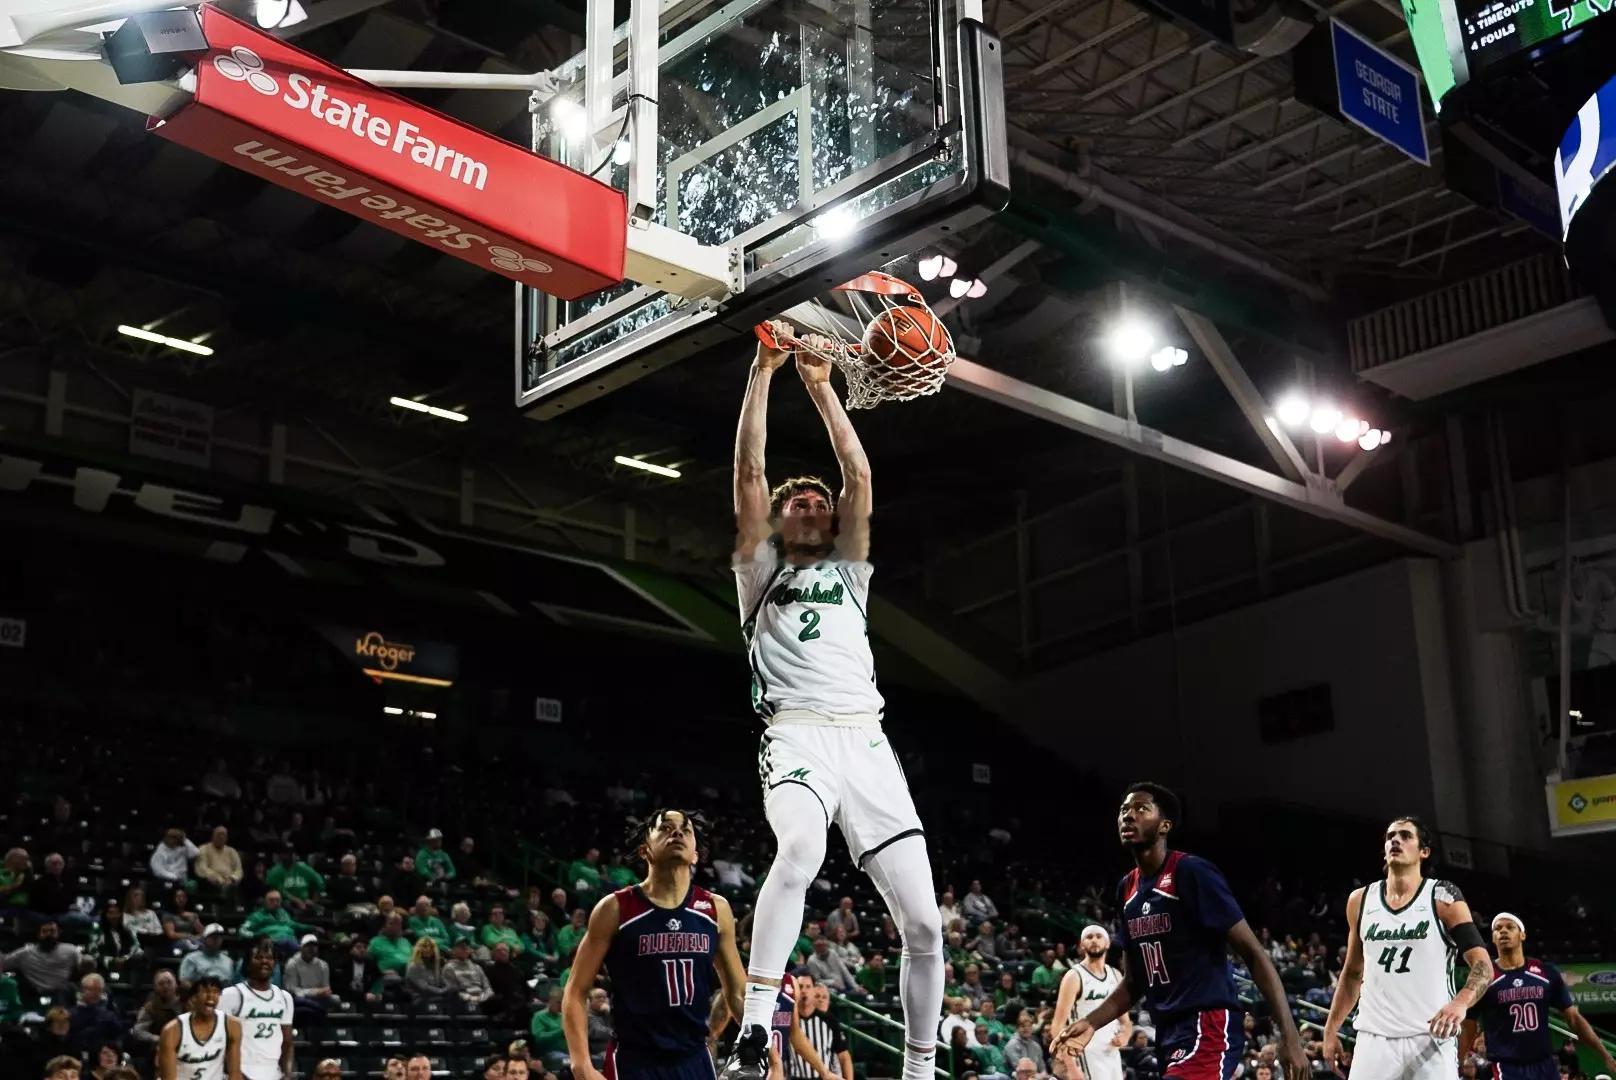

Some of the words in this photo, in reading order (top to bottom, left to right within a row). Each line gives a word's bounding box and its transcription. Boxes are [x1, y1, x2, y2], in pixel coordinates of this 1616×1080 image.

[1477, 0, 1534, 29] TIMEOUTS
[1471, 41, 1479, 51] 4
[1480, 23, 1516, 47] FOULS
[1355, 60, 1401, 103] GEORGIA
[1362, 87, 1399, 124] STATE
[764, 581, 843, 607] Marshall
[798, 609, 820, 642] 2
[356, 632, 415, 670] Kroger
[637, 932, 710, 957] BLUEFIELD
[1364, 920, 1430, 941] Marshall
[1139, 941, 1171, 988] 14
[1377, 945, 1413, 974] 41
[661, 958, 695, 1007] 11
[254, 1022, 277, 1039] 25
[1509, 1002, 1539, 1033] 20
[190, 1067, 206, 1080] 5
